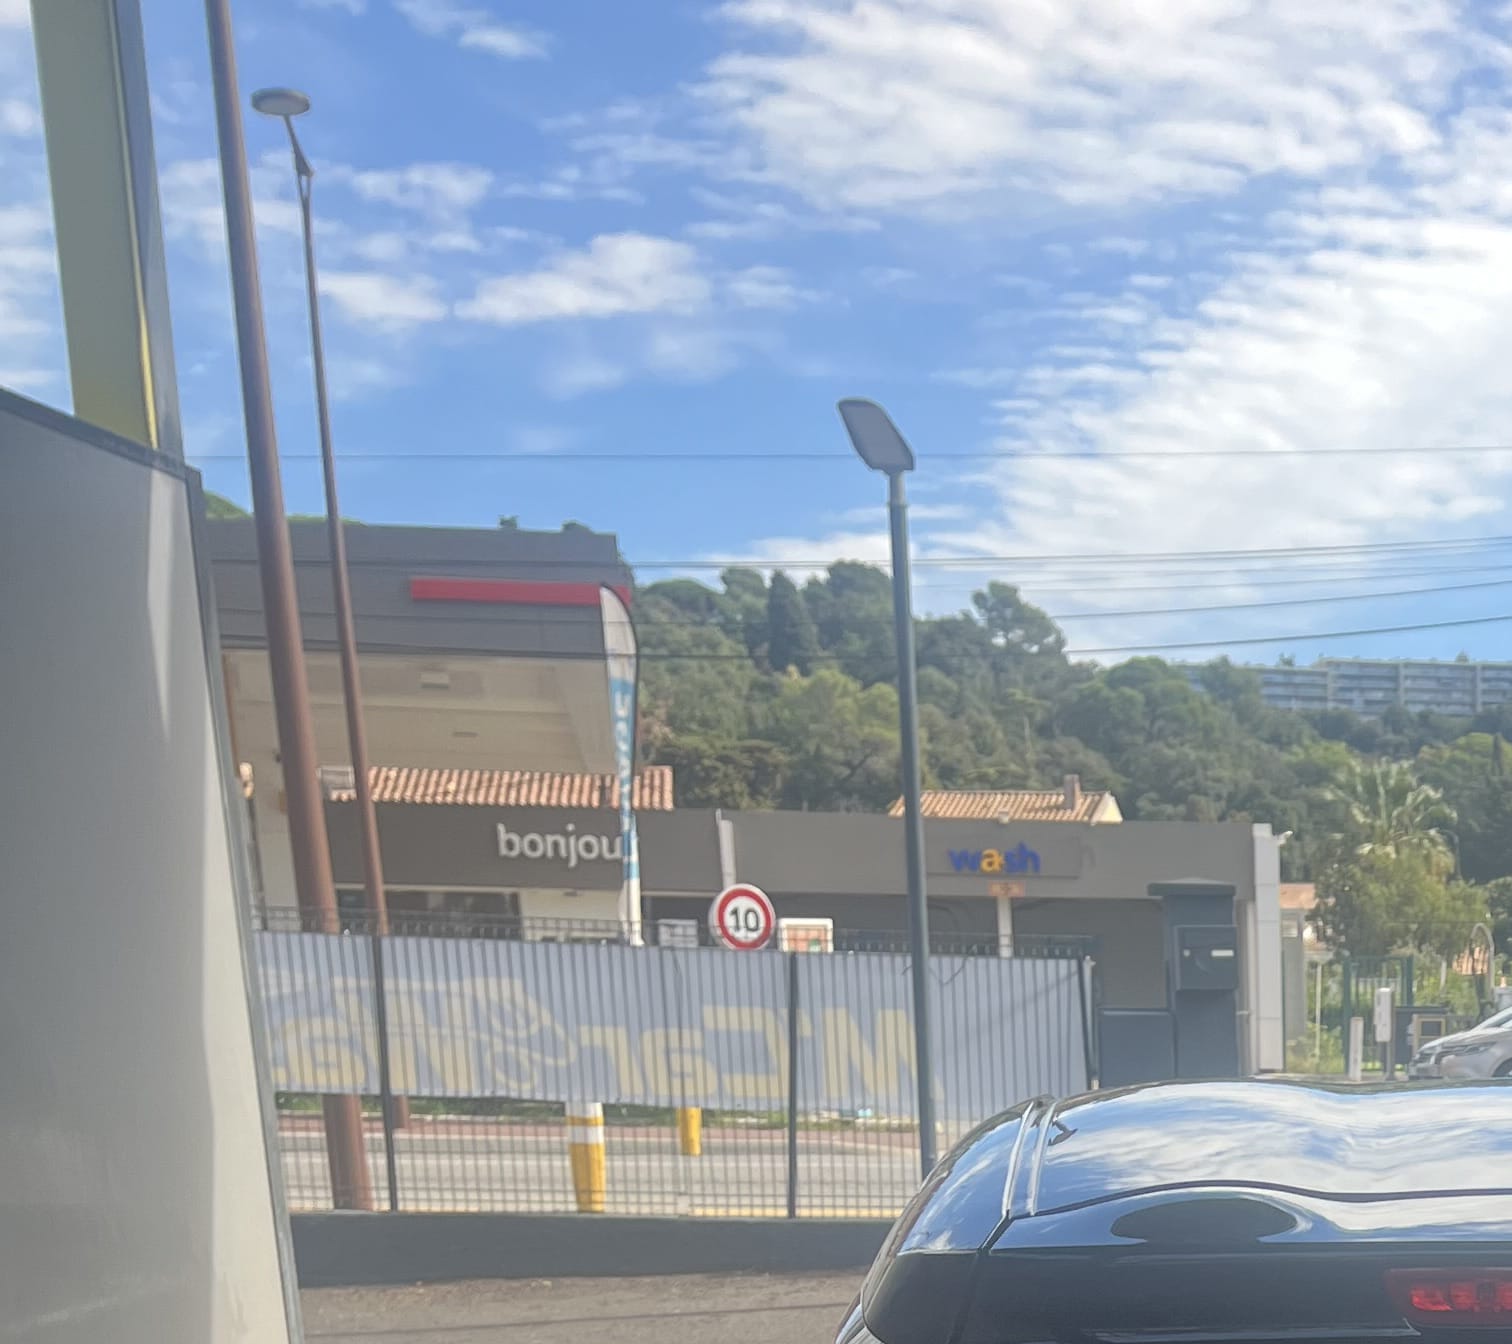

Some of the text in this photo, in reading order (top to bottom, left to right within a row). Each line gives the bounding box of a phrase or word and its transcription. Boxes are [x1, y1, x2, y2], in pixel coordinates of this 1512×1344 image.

[497, 823, 637, 868] bonjou
[947, 841, 1041, 873] wash
[729, 906, 760, 932] 10
